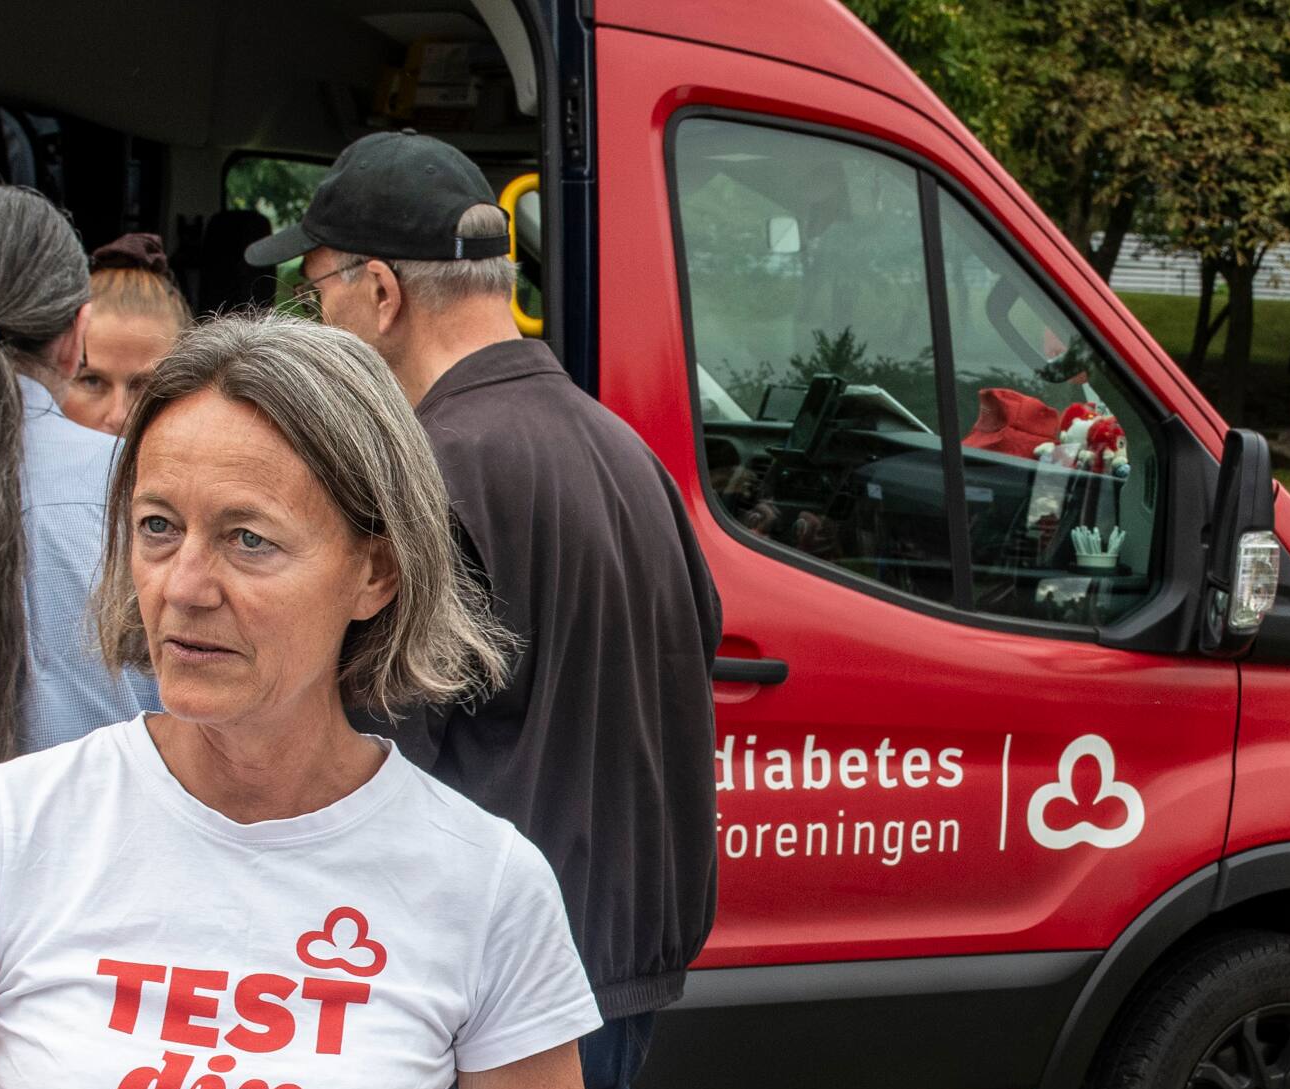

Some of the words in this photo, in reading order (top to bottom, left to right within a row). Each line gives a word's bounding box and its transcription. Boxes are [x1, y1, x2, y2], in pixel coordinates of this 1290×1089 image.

[715, 735, 965, 791] diabetes
[716, 811, 961, 867] oreningen
[97, 958, 371, 1055] TEST
